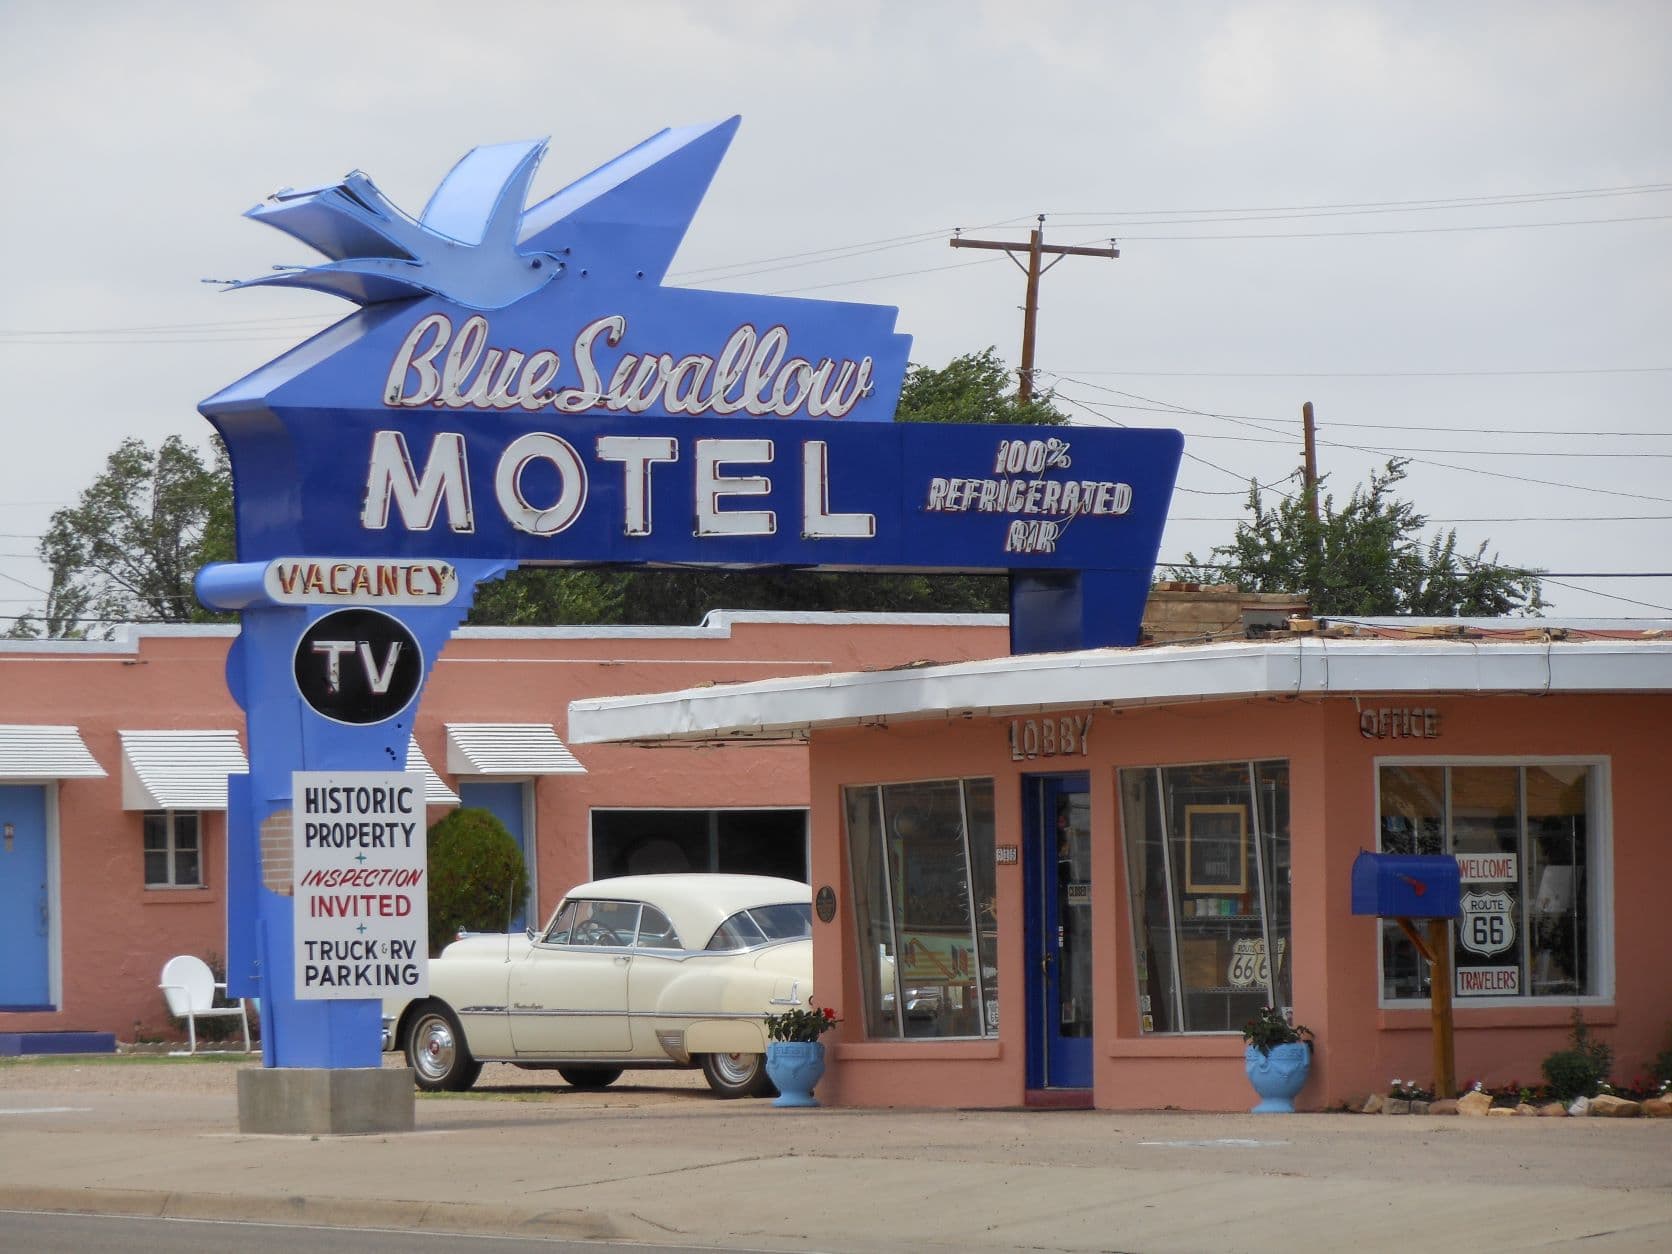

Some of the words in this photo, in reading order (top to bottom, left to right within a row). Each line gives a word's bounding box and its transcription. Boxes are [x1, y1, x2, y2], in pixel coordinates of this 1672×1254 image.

[384, 313, 560, 411] Blue
[553, 315, 874, 418] Swallow
[995, 437, 1072, 474] 100%
[360, 430, 876, 537] MOTEL
[926, 477, 1133, 515] REFRIGERATED
[1006, 519, 1059, 553] AIR
[277, 564, 456, 596] VACANCY
[312, 640, 403, 695] TV
[1009, 713, 1094, 761] LOBBY
[1360, 707, 1441, 739] OFFICE
[305, 786, 413, 814] HISTORIC
[305, 822, 416, 848] PROPERTY
[300, 868, 423, 888] INSPECTION
[1459, 859, 1513, 878] WELCOME
[310, 894, 412, 917] INVITED
[1471, 900, 1504, 910] ROUTE
[1473, 916, 1504, 945] 66
[304, 940, 378, 961] TRUCK
[390, 939, 417, 960] RV
[305, 963, 420, 987] PARKING
[1233, 955, 1253, 979] 66
[1459, 971, 1516, 990] TRAVELERS
